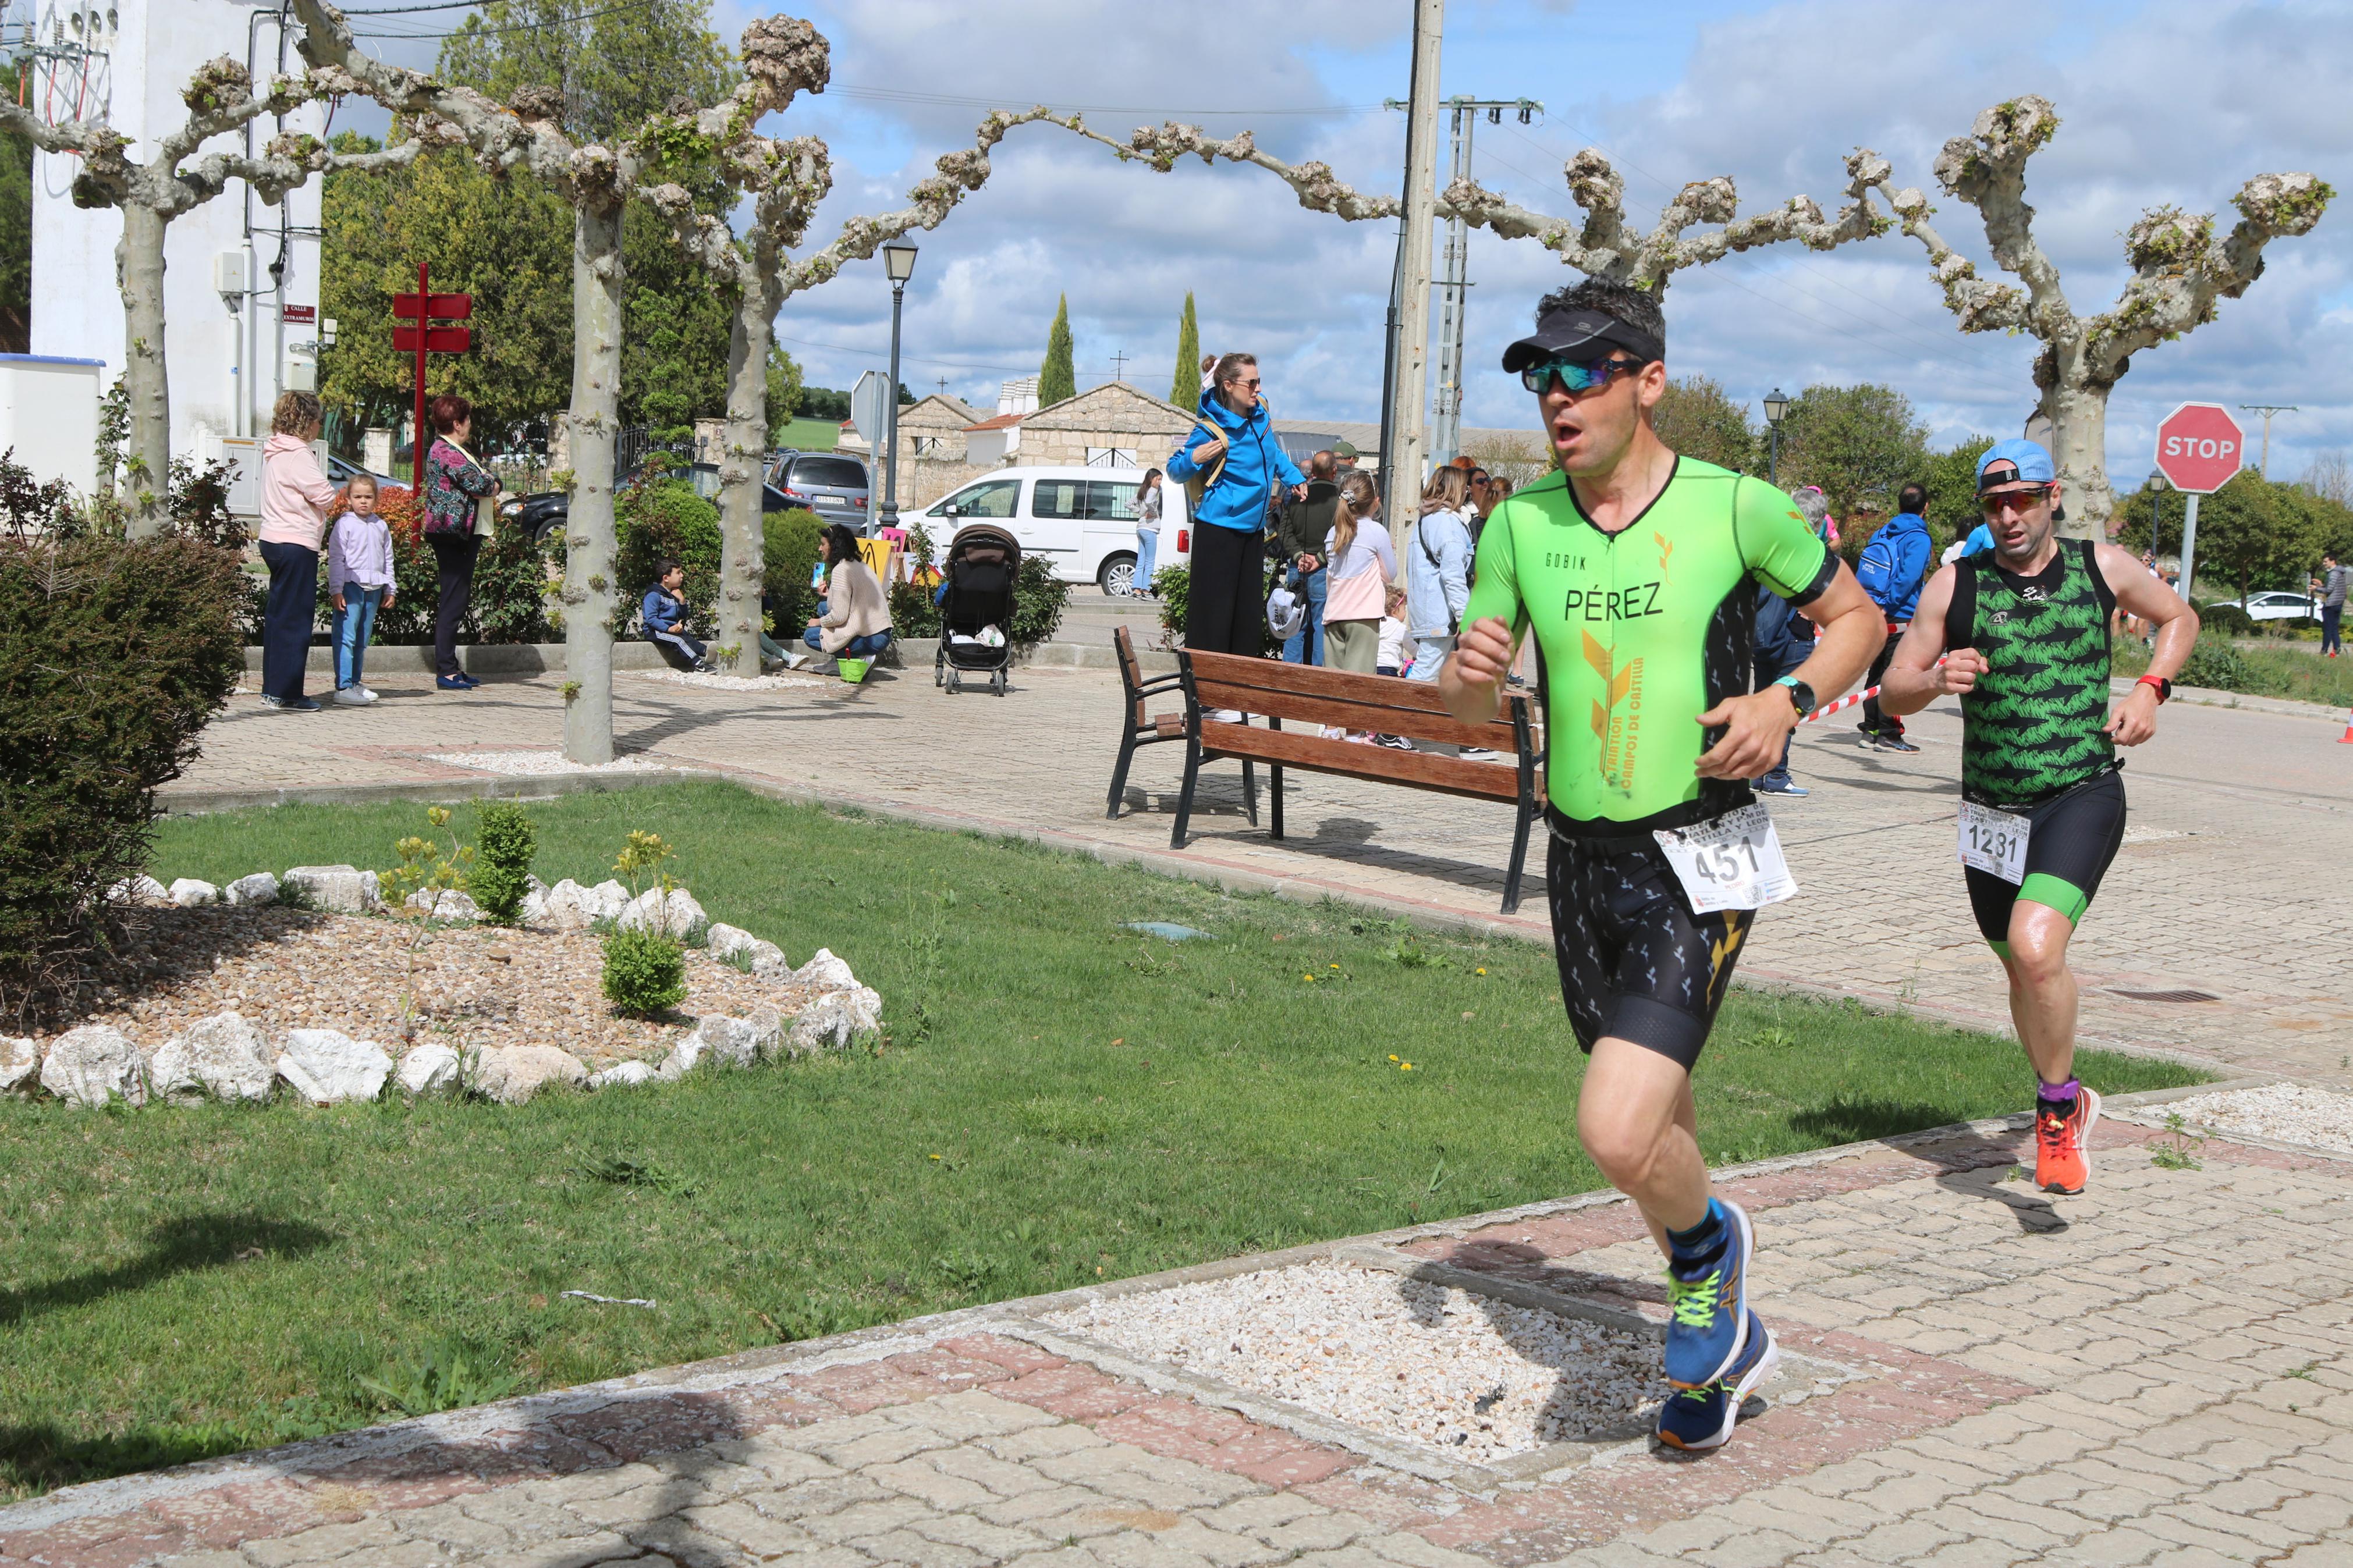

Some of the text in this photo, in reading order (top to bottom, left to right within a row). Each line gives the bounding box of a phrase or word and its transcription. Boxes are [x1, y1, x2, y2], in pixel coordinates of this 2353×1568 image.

[2164, 436, 2235, 460] STOP
[1546, 552, 1586, 571] GOBIK
[1564, 582, 1663, 621] PÉREZ
[1620, 657, 1644, 790] CAMPOS DE CASTILLA
[1753, 802, 1765, 810] DE
[1970, 815, 2004, 829] CASTILLA
[1678, 828, 1732, 848] CASTILLA
[1968, 824, 2017, 863] 1281
[1695, 835, 1759, 884] 451
